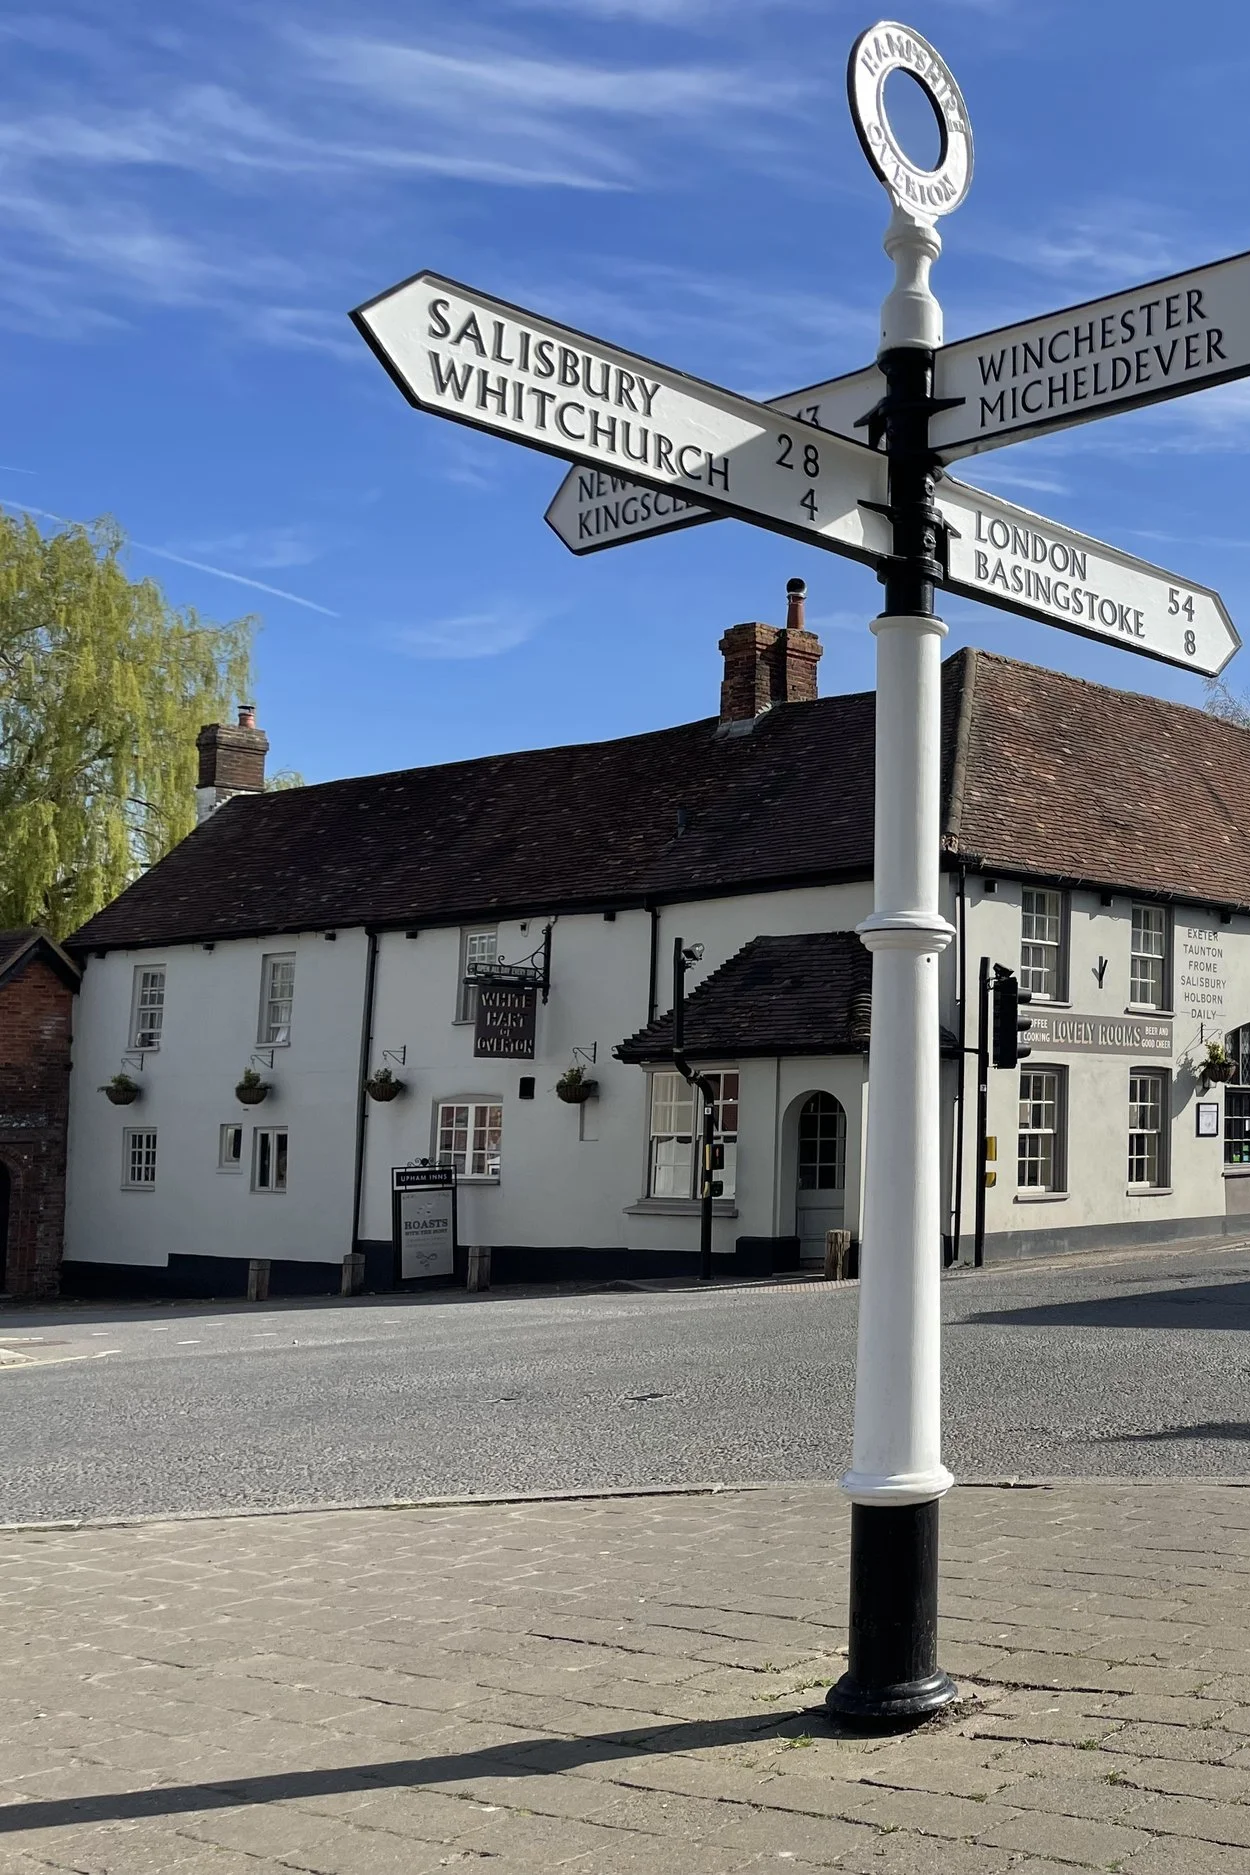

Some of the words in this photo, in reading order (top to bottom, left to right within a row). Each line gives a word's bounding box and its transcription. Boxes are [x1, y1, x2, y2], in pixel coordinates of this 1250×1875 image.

[861, 33, 966, 132] HAMPSHIRE
[866, 121, 958, 206] OVERTON
[978, 288, 1207, 386] WINCHESTER
[979, 327, 1228, 428] MICHELDEVER
[427, 299, 662, 417] SALISBURY
[776, 433, 819, 478] 28
[428, 350, 730, 491] WHITCHURCH
[800, 488, 819, 521] 4
[974, 510, 1087, 581] LONDON
[1167, 587, 1195, 622] 54
[974, 549, 1145, 639] BASINGSTOKE
[1184, 630, 1196, 656] 8
[1187, 928, 1219, 942] EXETER
[1183, 944, 1223, 958] TAUNTON
[1188, 960, 1218, 973] FROME
[1180, 975, 1227, 989] SALISBURY
[481, 992, 532, 1008] WHITE
[1184, 992, 1223, 1005] HOLBORN
[486, 1011, 528, 1028] HART
[1190, 1008, 1217, 1021] DAILY
[1023, 1032, 1050, 1042] COOKING
[1052, 1020, 1095, 1045] LOVELY
[1099, 1023, 1142, 1047] ROOMS
[1145, 1026, 1158, 1036] BEER
[1159, 1027, 1169, 1036] AND
[477, 1037, 532, 1054] OVERTON
[1141, 1038, 1155, 1048] GOOD
[1156, 1039, 1171, 1049] CHEER
[404, 1218, 448, 1230] ROASTS
